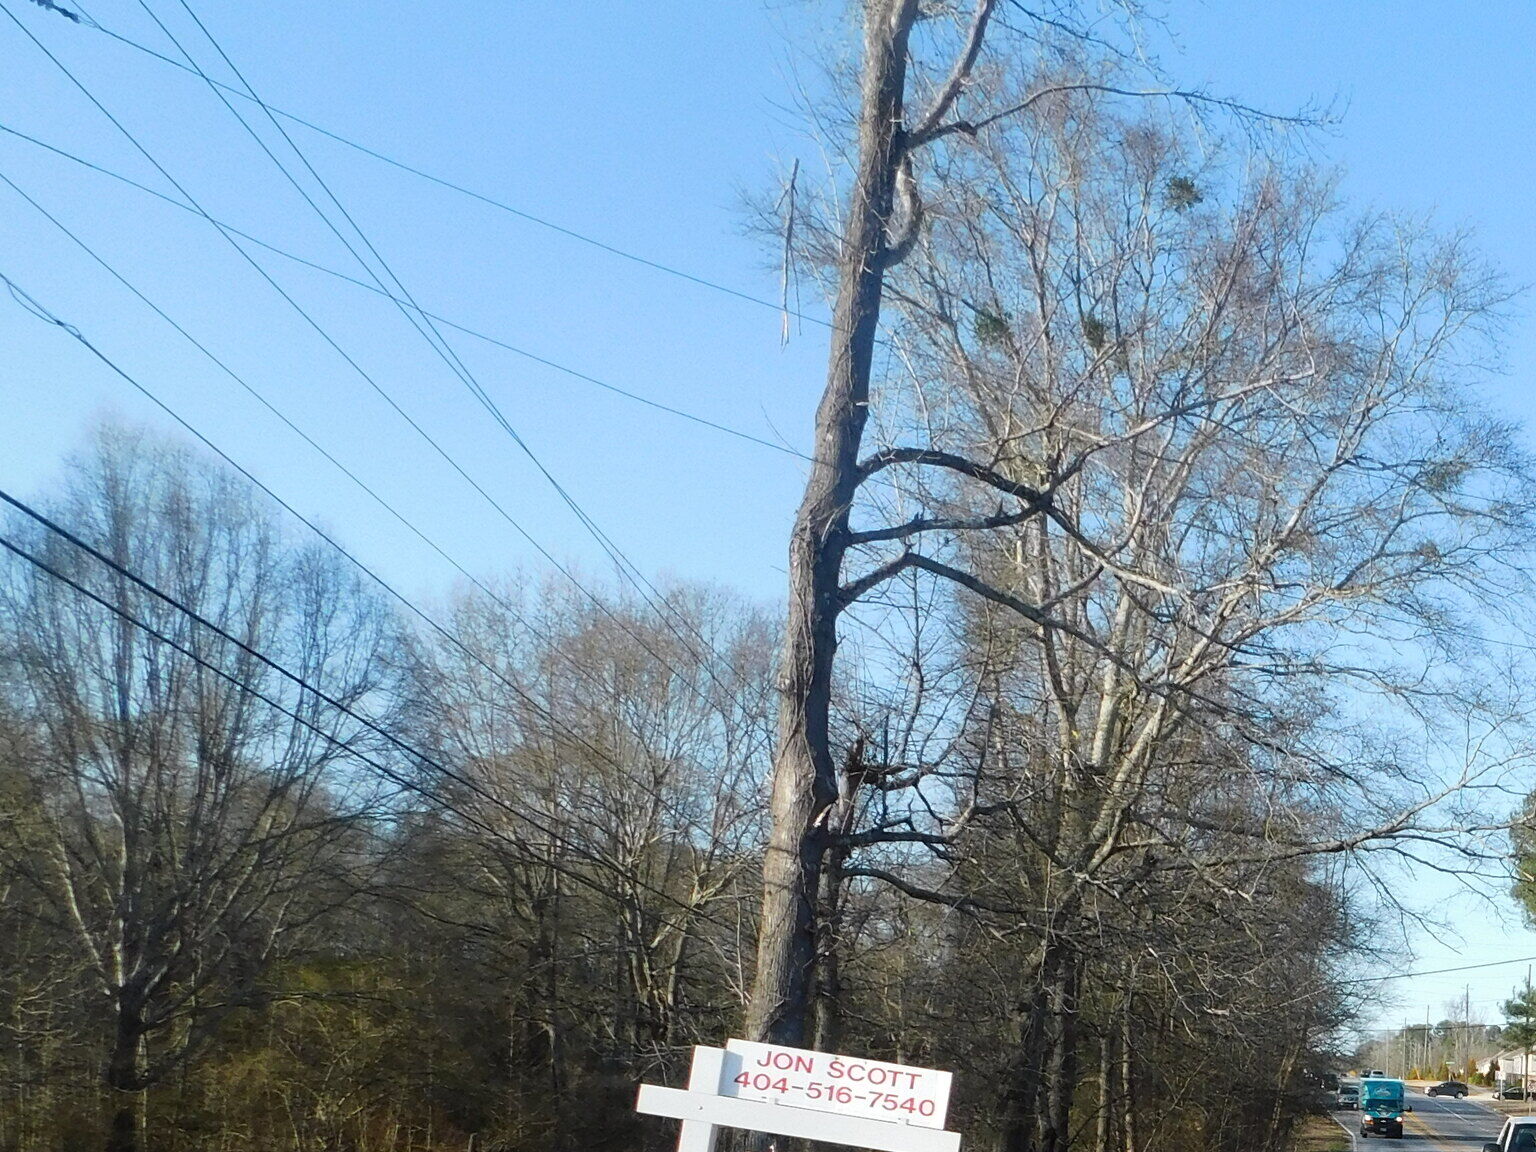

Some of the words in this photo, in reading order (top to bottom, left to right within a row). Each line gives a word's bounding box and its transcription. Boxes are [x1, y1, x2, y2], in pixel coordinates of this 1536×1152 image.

[756, 1051, 814, 1074] JON
[827, 1060, 922, 1090] SCOTT
[733, 1071, 935, 1117] 404-516-7540
